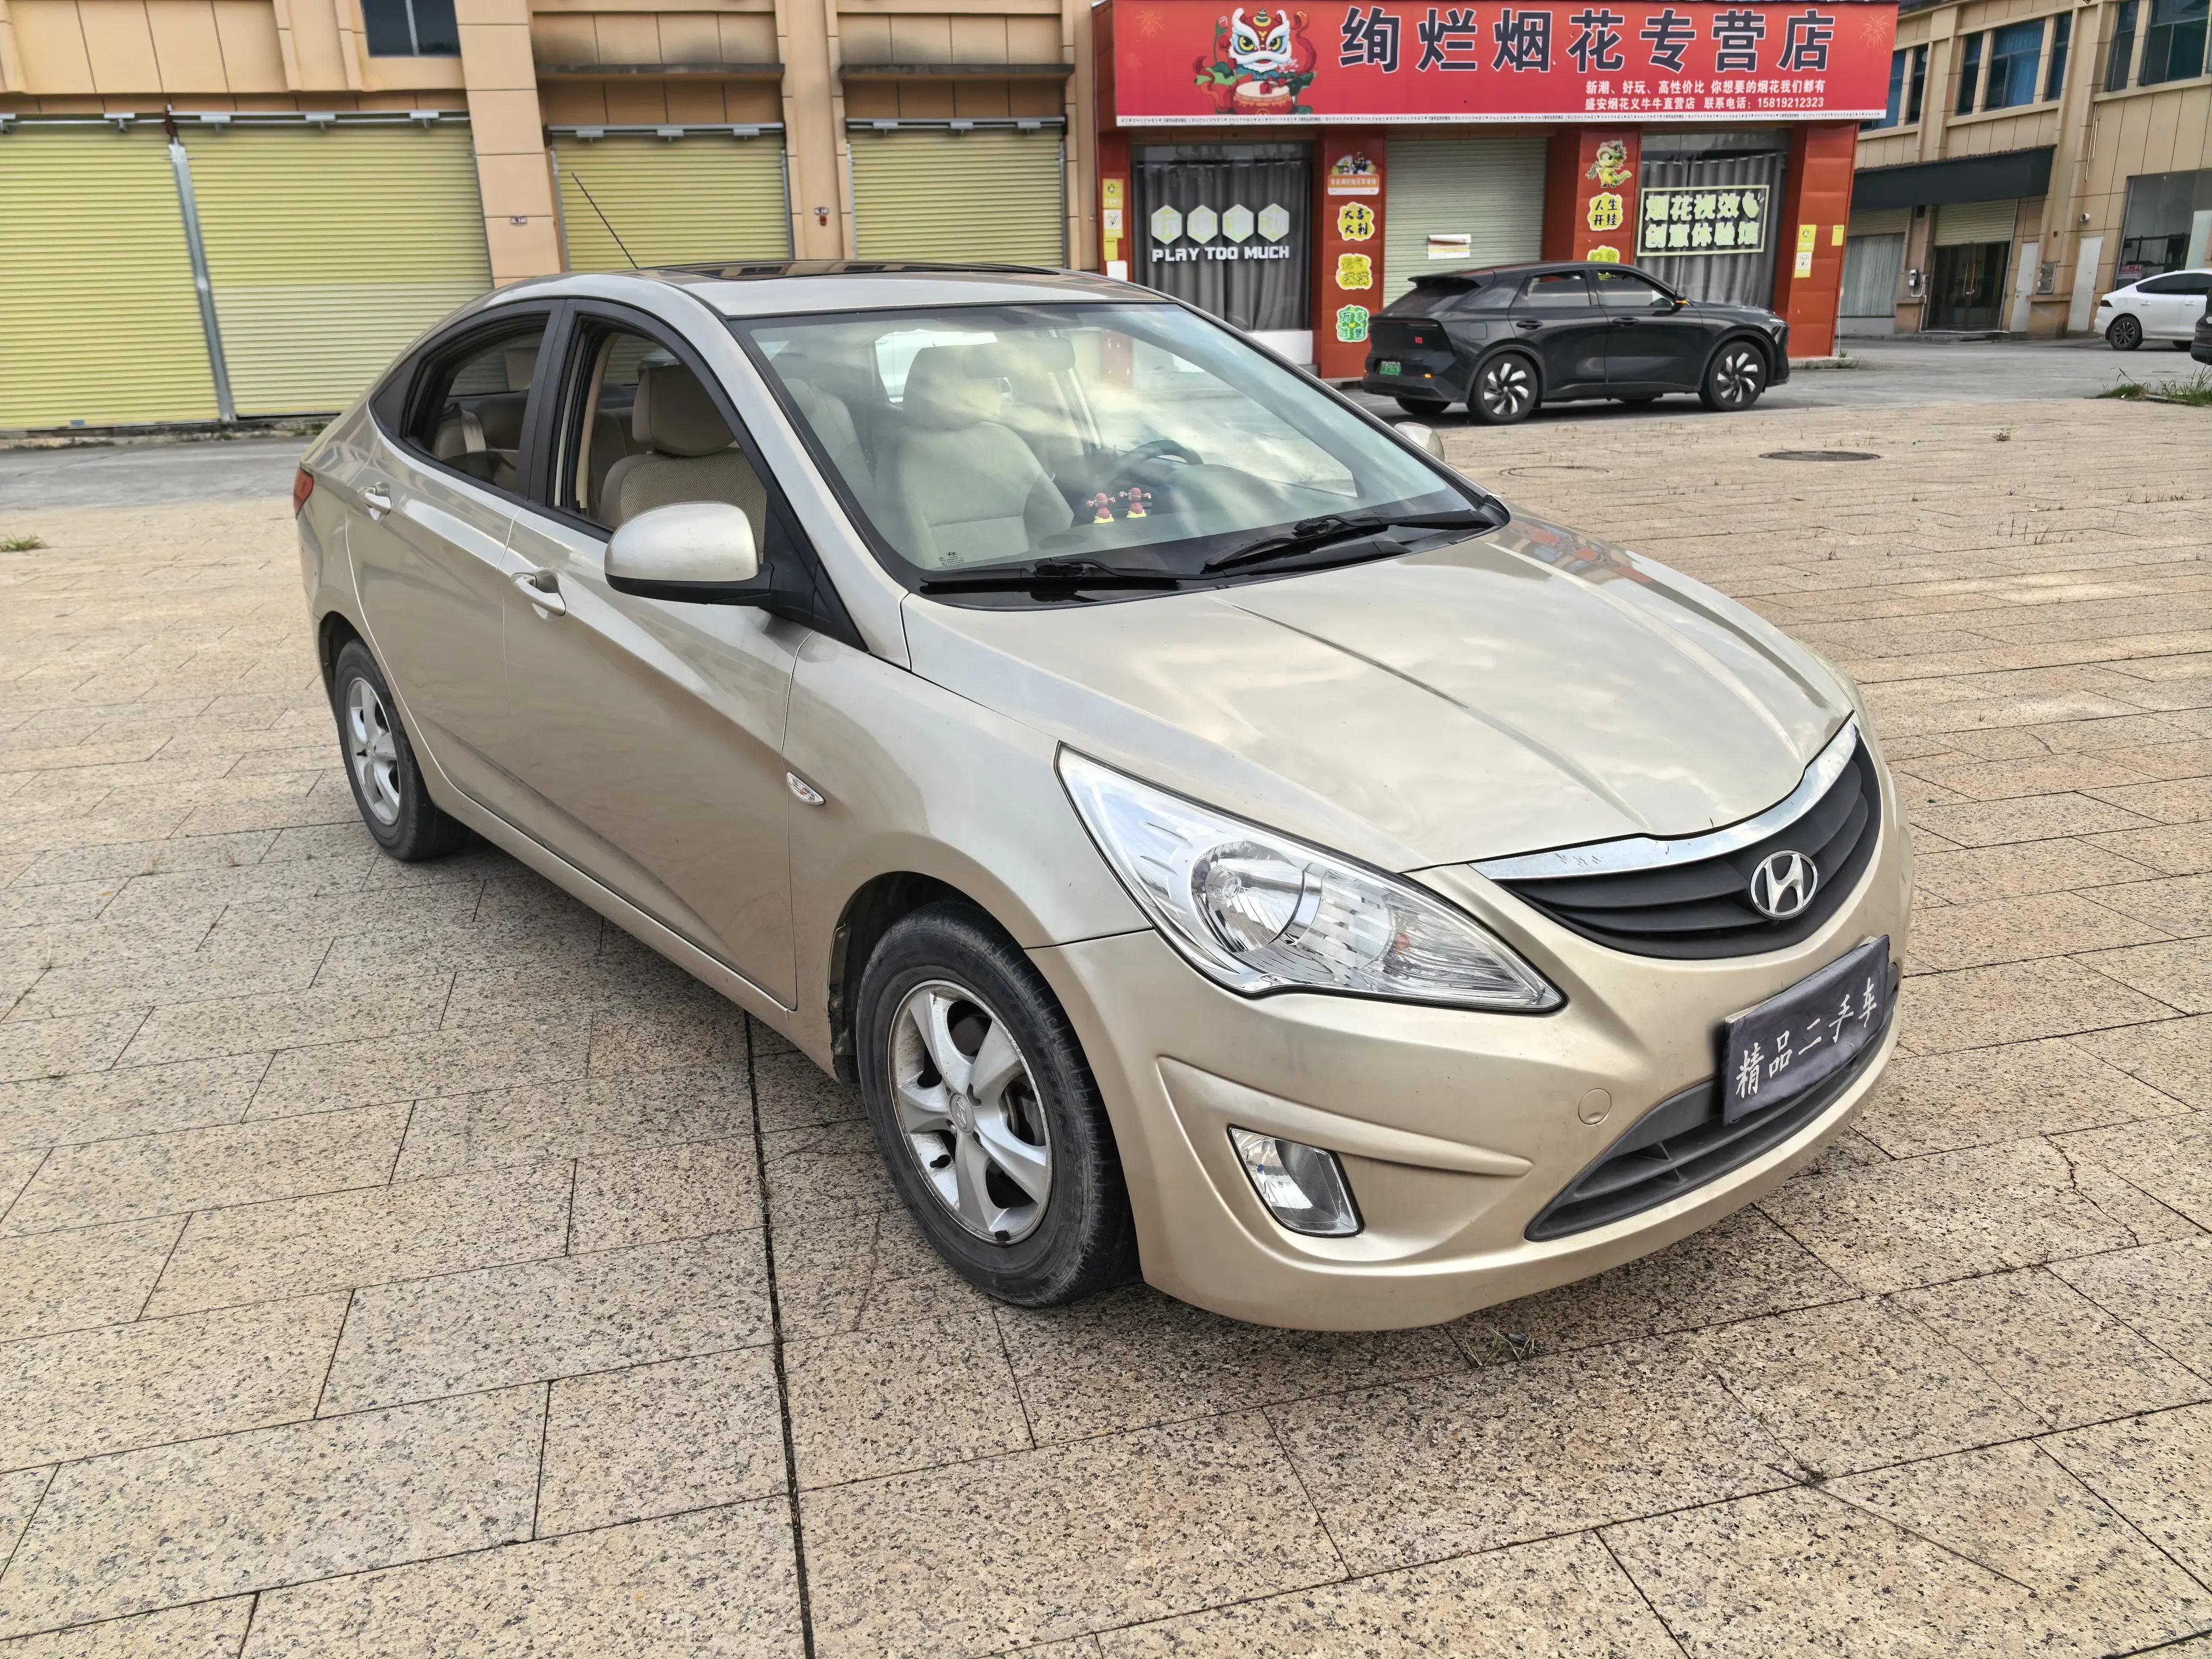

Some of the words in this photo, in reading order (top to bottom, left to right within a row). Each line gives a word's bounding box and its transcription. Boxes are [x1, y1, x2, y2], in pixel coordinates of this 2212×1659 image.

[1338, 5, 1835, 73] 绚烂烟花专营店
[1586, 79, 1704, 95] 新潮、好玩、高性价比
[1711, 79, 1825, 94] 你想要的烟花我们都有
[1585, 96, 1696, 111] 盛安烟花义牛牛直营店
[1595, 198, 1618, 211] 人生
[1345, 207, 1364, 220] 大吉
[1593, 213, 1618, 226] 开挂
[1345, 222, 1368, 235] 大利
[1152, 247, 1199, 262] PLAY
[1204, 247, 1239, 260] TOO
[1244, 246, 1290, 259] MUCH
[1735, 977, 1877, 1098] 精品二手车
